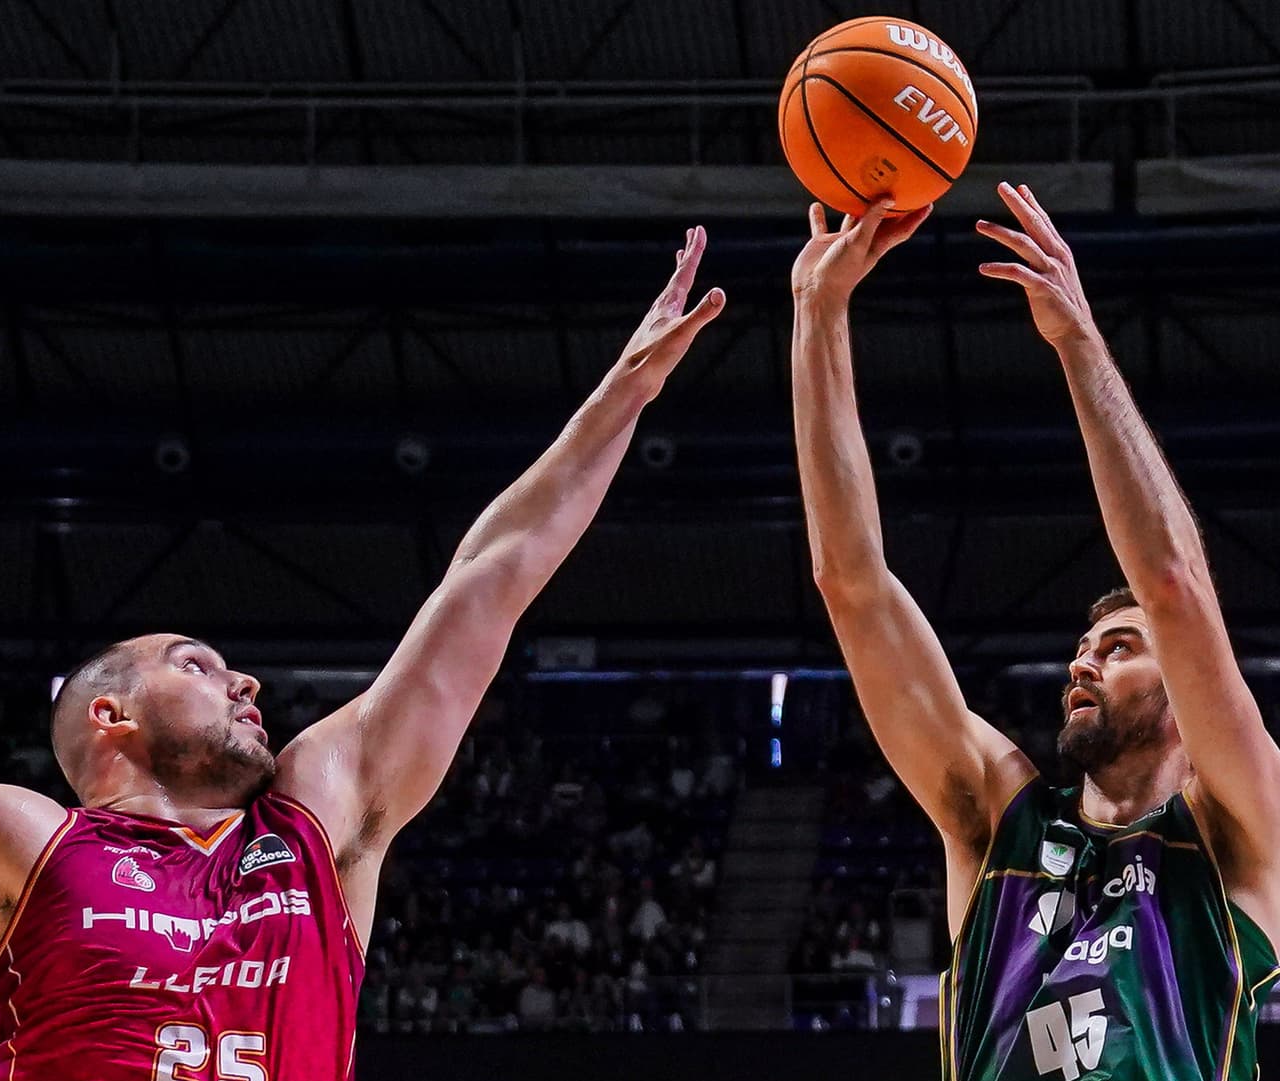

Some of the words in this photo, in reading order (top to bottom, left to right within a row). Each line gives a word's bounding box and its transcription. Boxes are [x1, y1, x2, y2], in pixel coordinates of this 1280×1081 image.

[885, 24, 978, 112] Wilso
[1103, 854, 1156, 897] caja
[1064, 925, 1133, 965] aga
